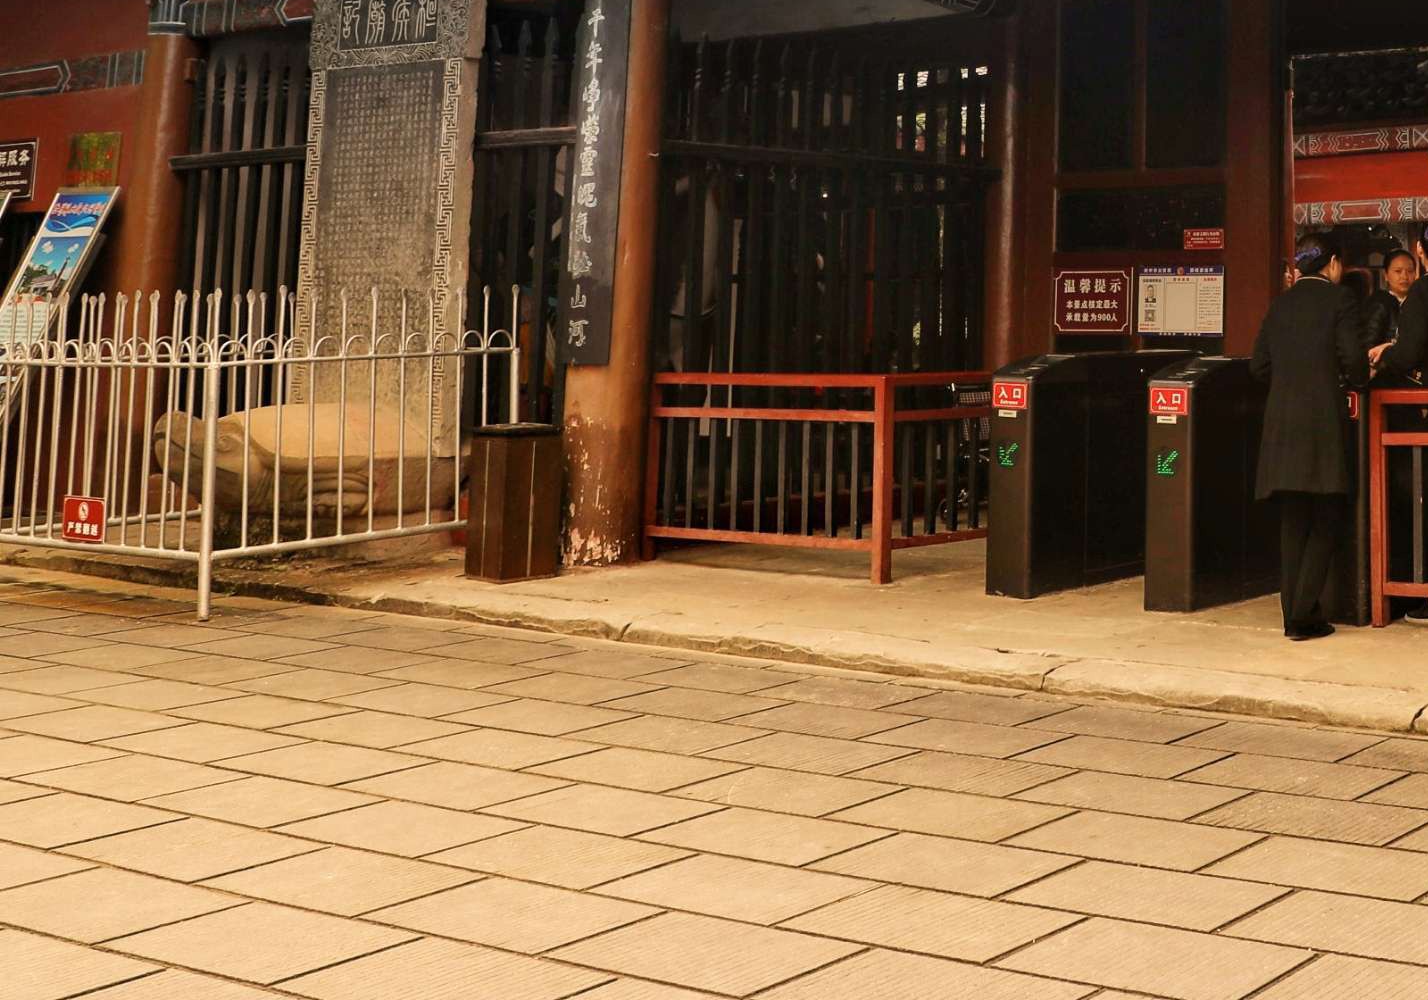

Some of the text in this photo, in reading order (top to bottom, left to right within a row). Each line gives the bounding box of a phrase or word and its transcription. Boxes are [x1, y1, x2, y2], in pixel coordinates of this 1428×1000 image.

[1063, 278, 1122, 294] 温馨提示
[998, 386, 1022, 399] 入口
[1156, 391, 1182, 405] 入口
